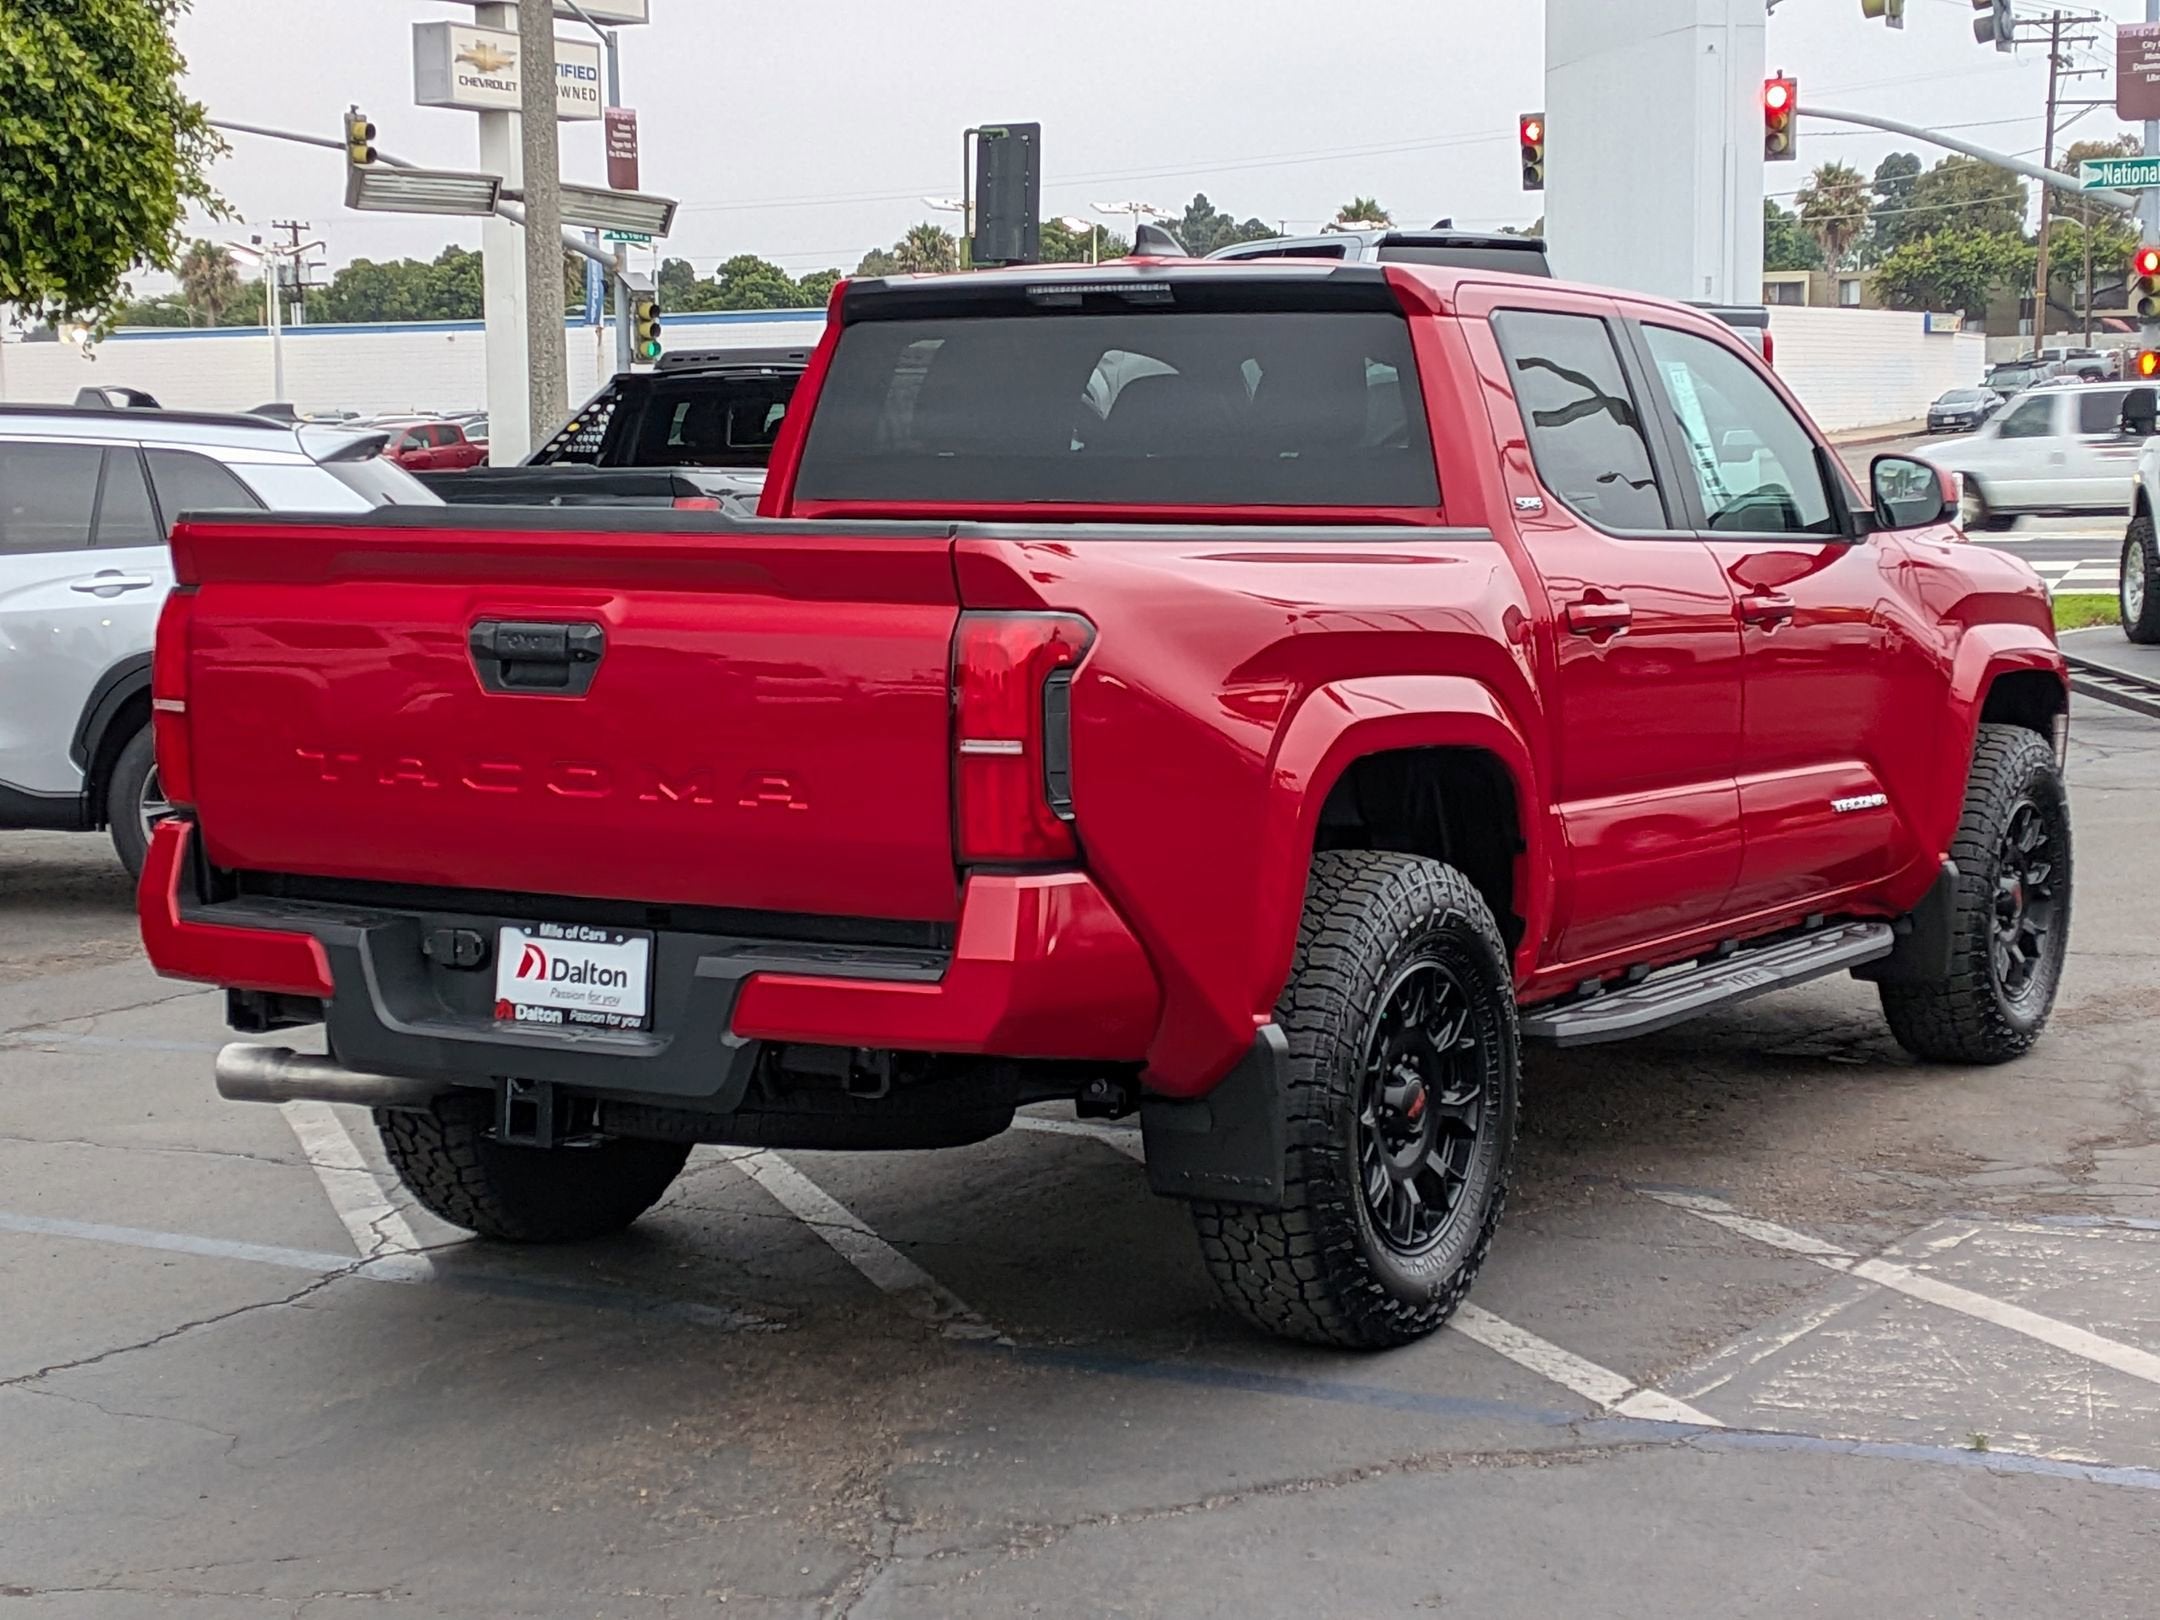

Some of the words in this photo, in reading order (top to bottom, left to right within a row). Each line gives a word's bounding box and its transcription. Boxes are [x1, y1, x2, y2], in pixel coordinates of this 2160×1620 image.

[458, 74, 517, 92] CHEVROLET
[295, 747, 809, 811] TACOMA
[539, 923, 563, 939] Mile
[565, 926, 577, 939] of
[579, 926, 607, 942] Cars
[551, 957, 628, 988] Dalton
[550, 987, 586, 1001] Passion
[587, 990, 601, 1004] for
[602, 993, 622, 1006] you
[515, 1004, 563, 1024] Dalton
[569, 1009, 606, 1024] Passion
[606, 1012, 620, 1026] for
[621, 1015, 642, 1028] you
